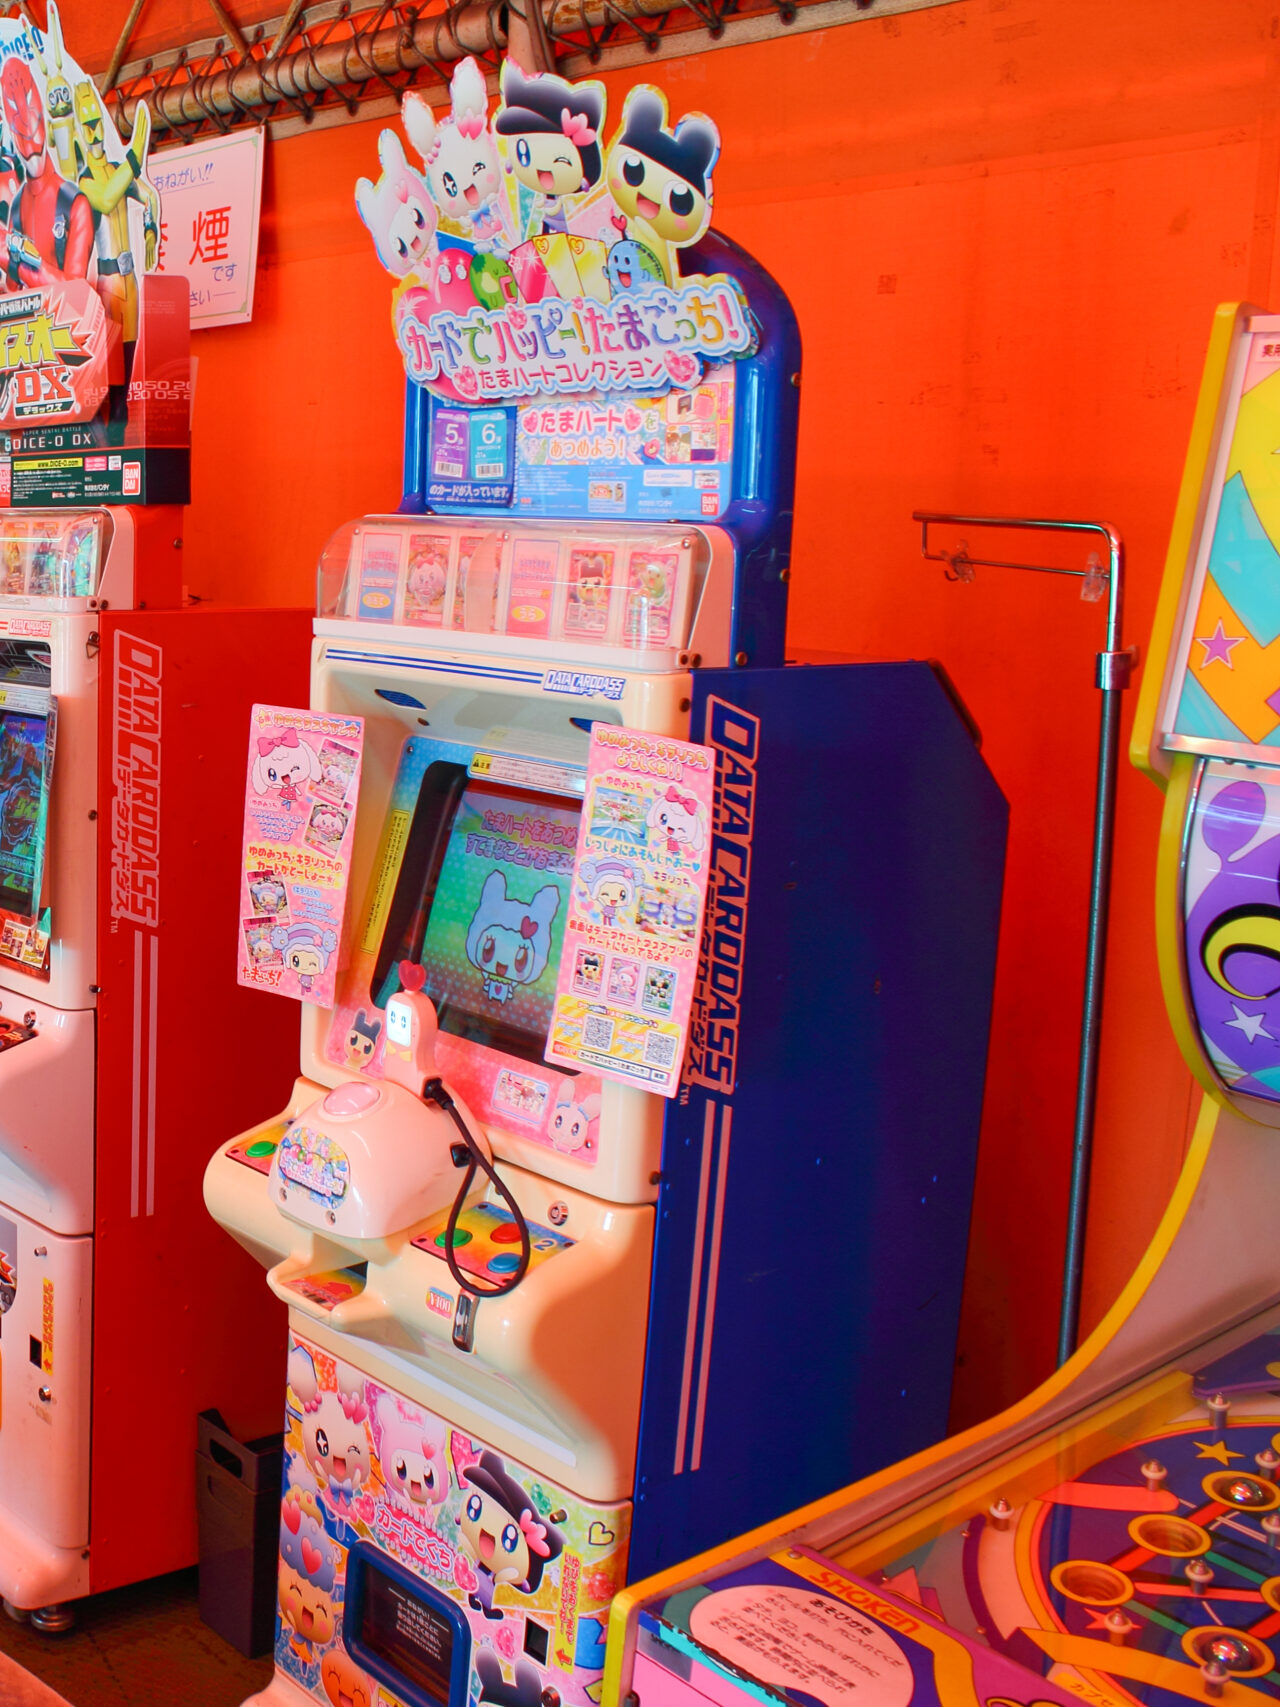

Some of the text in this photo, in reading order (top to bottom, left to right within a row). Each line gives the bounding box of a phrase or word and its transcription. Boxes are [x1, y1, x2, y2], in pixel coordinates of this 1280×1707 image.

[212, 263, 237, 282] です
[16, 366, 73, 404] DX
[479, 357, 664, 391] たまハートコレクション
[539, 409, 660, 435] たまハート を
[12, 432, 93, 450] DICE-O DX
[124, 468, 139, 480] BAN
[124, 479, 137, 491] DAI
[680, 1086, 690, 1106] TM
[534, 1239, 555, 1251] 2
[377, 1507, 452, 1570] カードでぐち
[808, 1570, 920, 1634] SHOKEN
[809, 1597, 875, 1637] あそびかた
